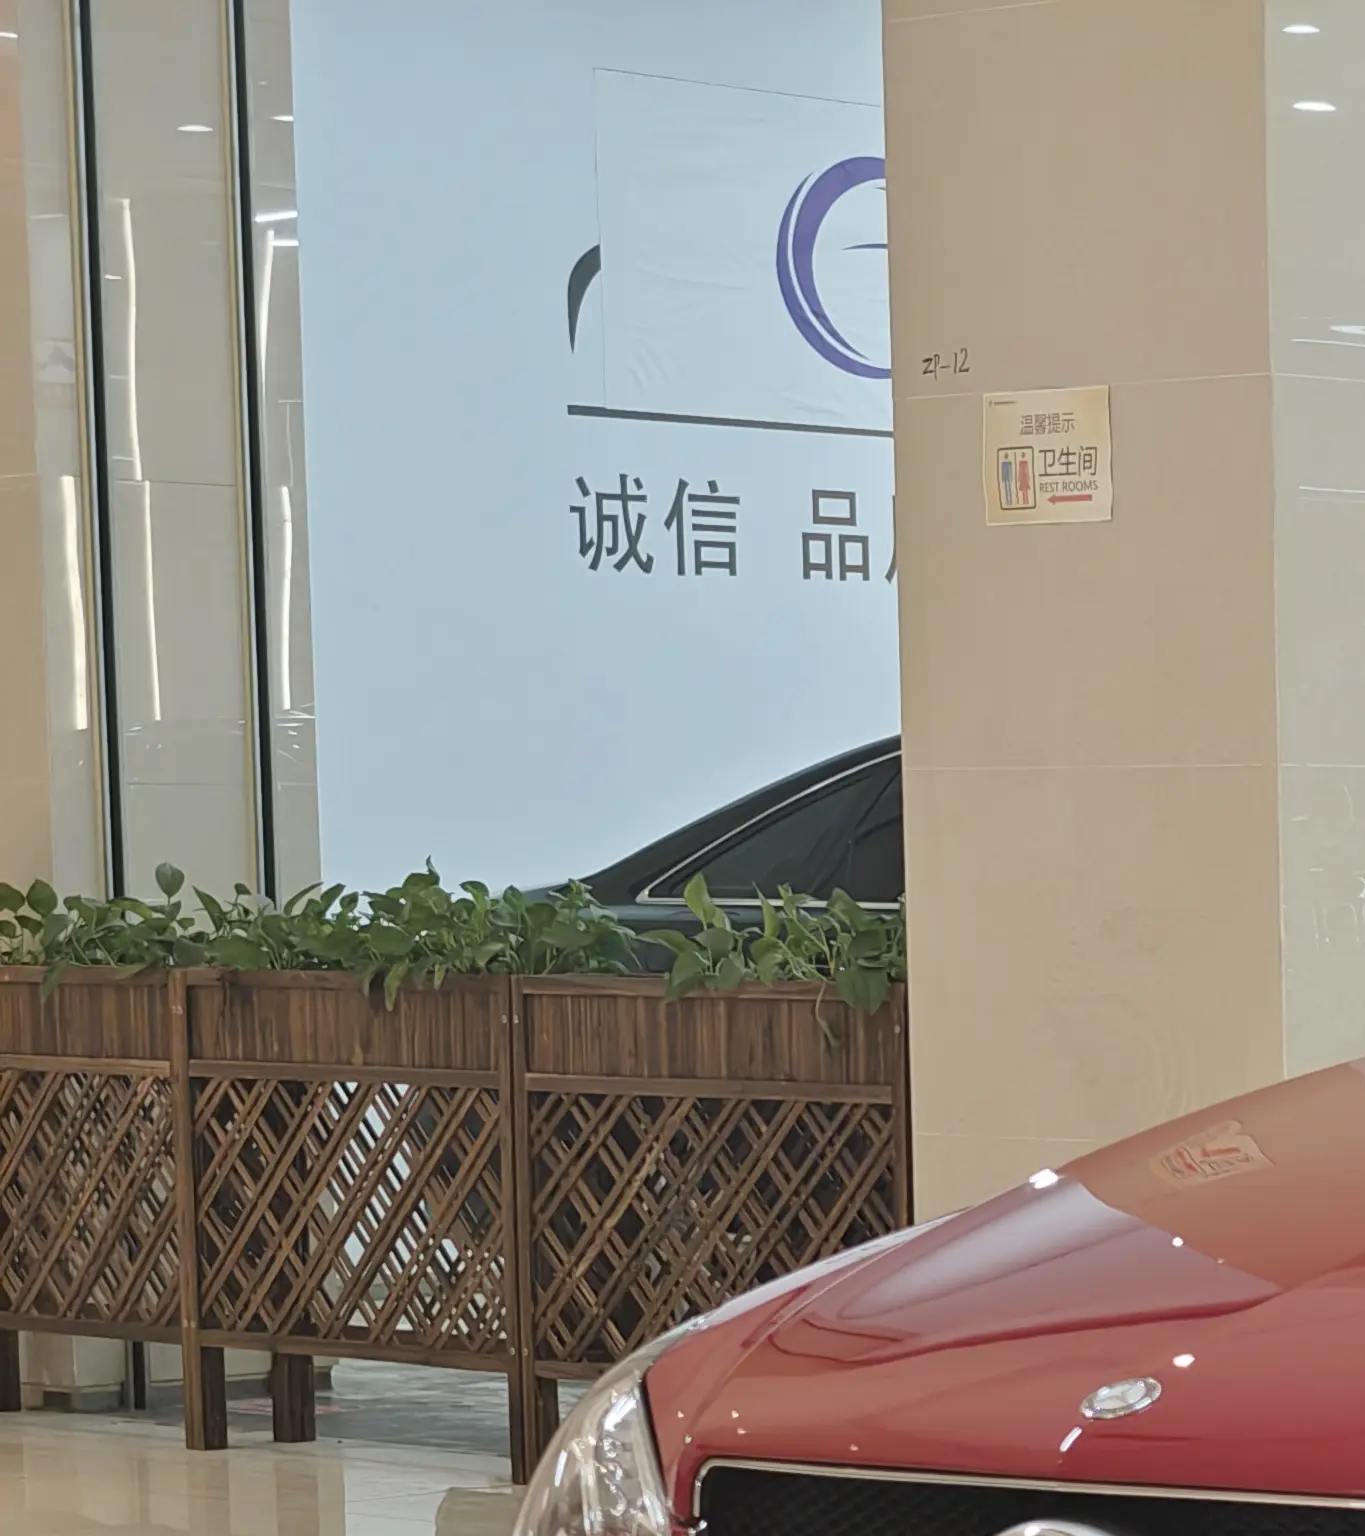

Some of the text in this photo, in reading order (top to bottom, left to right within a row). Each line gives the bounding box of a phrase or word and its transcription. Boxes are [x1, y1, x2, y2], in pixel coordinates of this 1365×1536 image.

[1019, 412, 1076, 436] 温馨提示
[1038, 446, 1098, 477] 卫生间
[1039, 480, 1099, 493] REST ROOMS
[569, 473, 897, 584] 诚信 品
